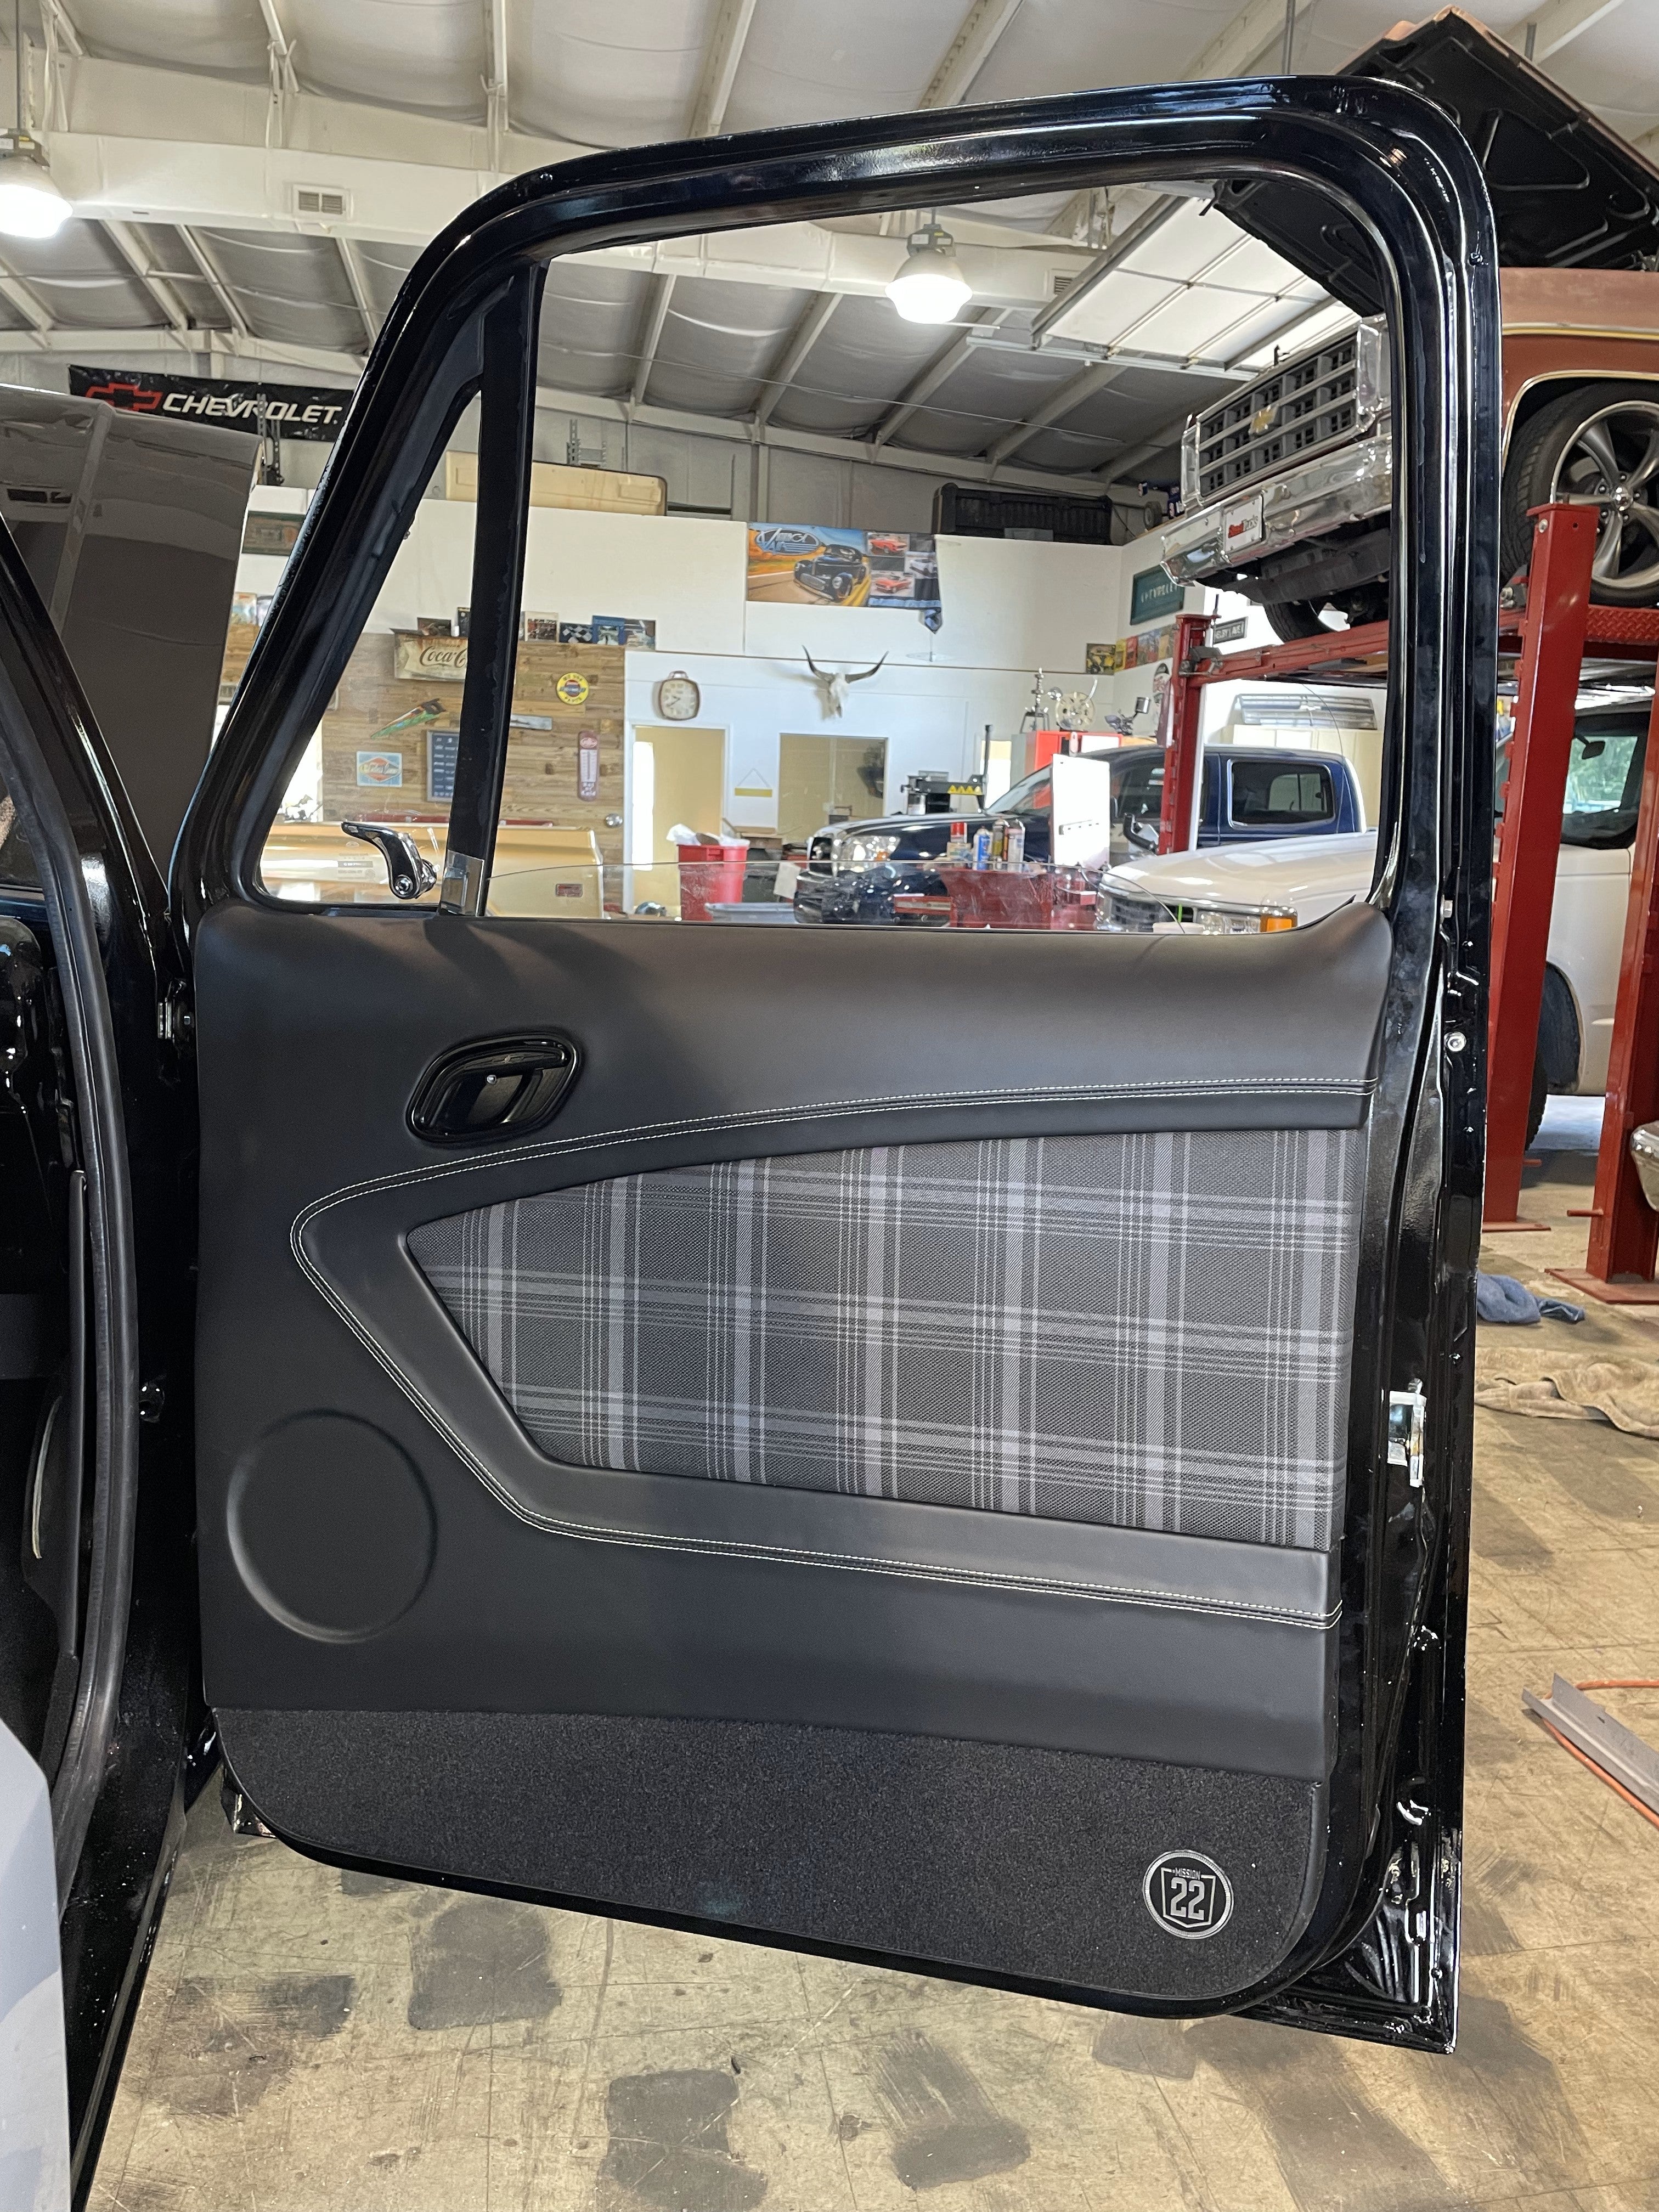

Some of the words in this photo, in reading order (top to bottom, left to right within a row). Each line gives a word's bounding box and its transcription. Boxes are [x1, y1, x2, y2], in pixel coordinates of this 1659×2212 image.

[162, 392, 343, 425] CHEVROLET
[419, 646, 468, 668] Coca-C
[1175, 1867, 1201, 1880] MISSION
[1170, 1877, 1205, 1920] 22
